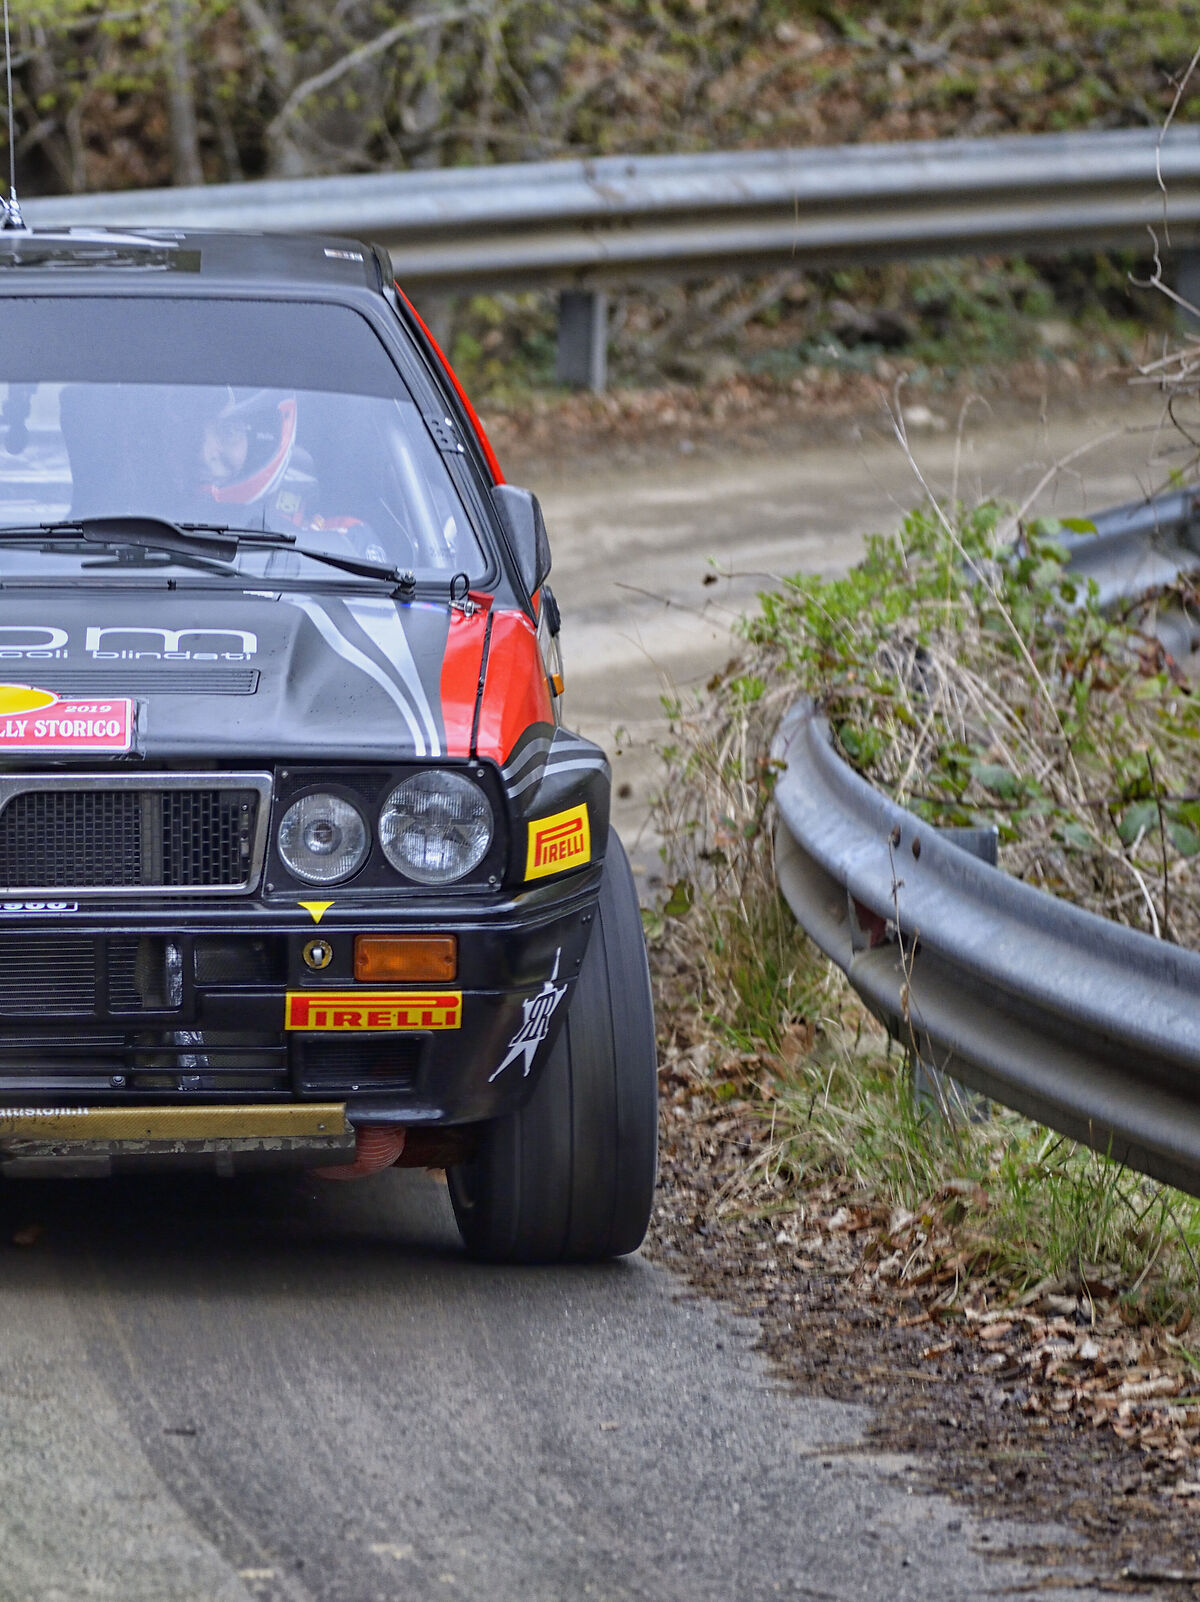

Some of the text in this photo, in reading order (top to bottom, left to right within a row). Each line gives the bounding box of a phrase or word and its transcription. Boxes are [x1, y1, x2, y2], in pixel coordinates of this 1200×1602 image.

[91, 649, 252, 661] blindati
[64, 703, 112, 713] 2019
[34, 719, 121, 737] STORICO
[534, 816, 585, 868] PIRELLI
[290, 996, 460, 1026] PIRELLI
